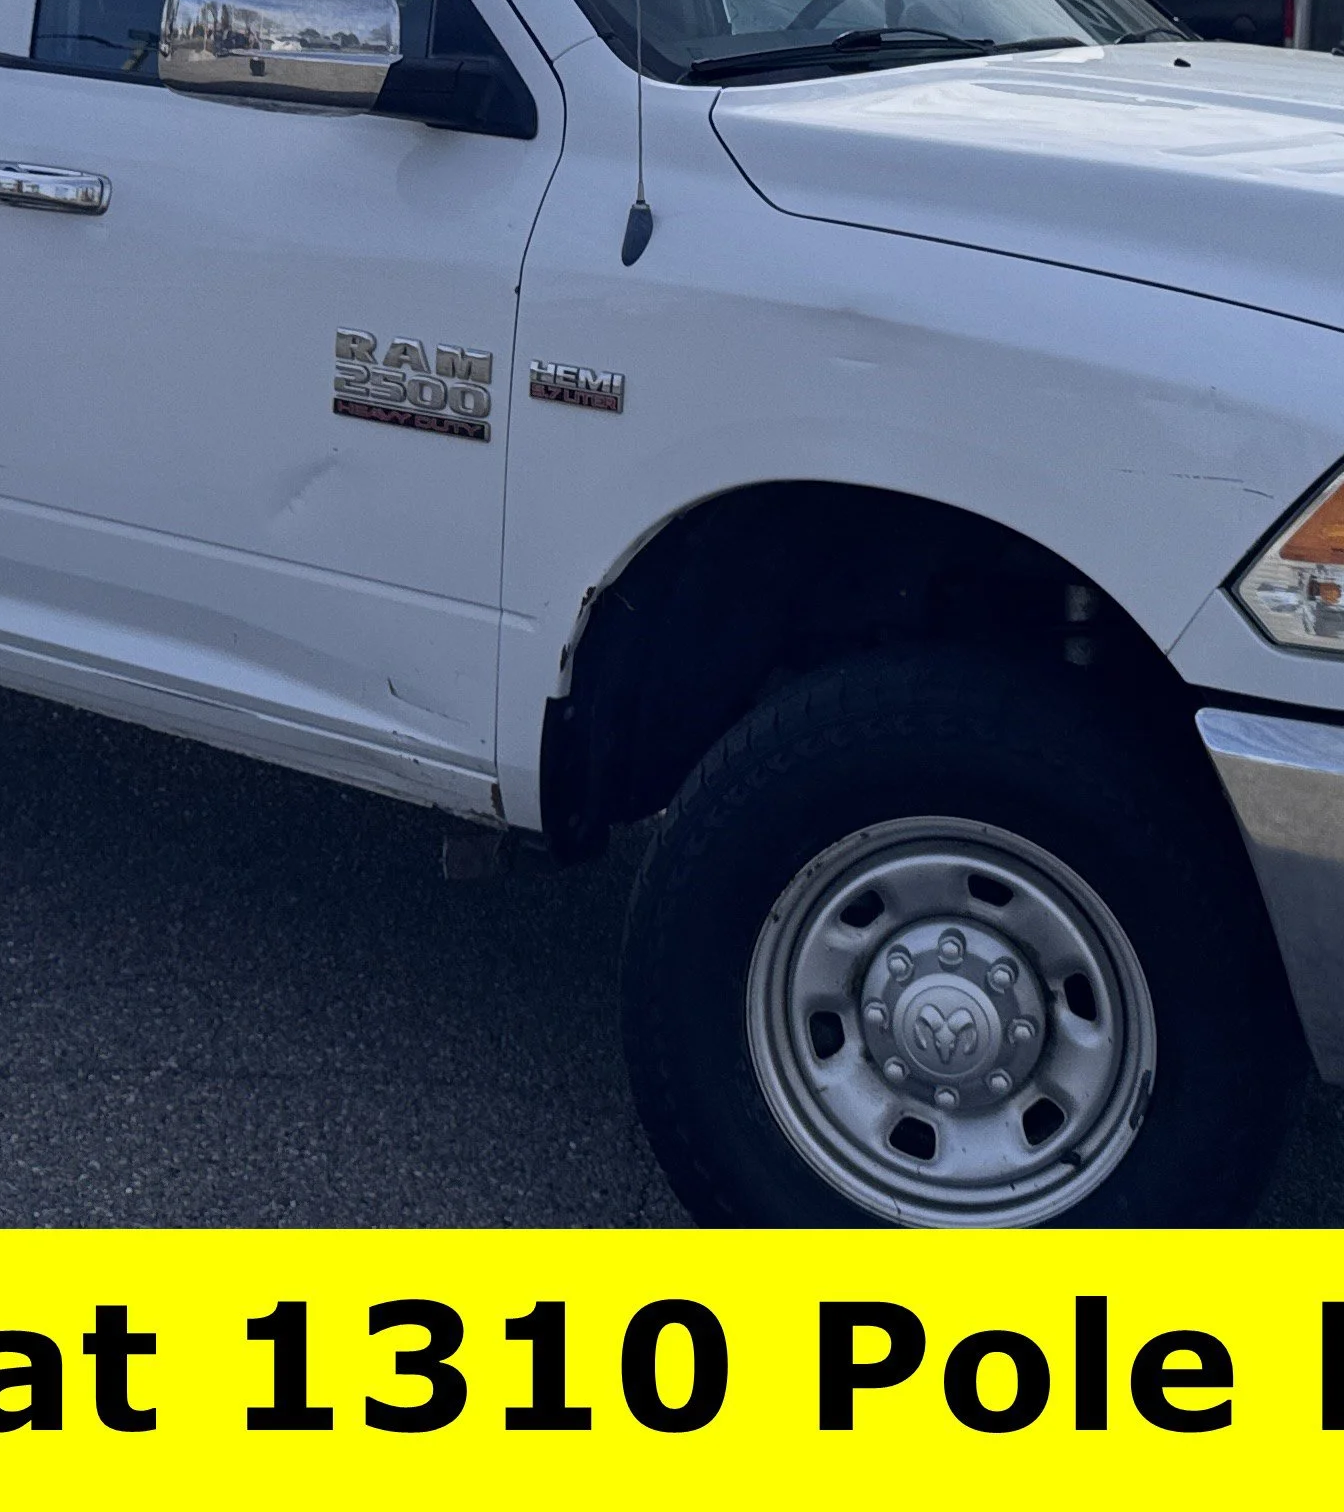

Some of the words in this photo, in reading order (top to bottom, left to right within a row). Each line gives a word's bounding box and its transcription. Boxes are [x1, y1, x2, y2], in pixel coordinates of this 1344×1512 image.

[335, 326, 493, 384] RAM
[334, 360, 492, 419] 2500
[530, 359, 625, 396] HEMI
[531, 383, 562, 400] 5.7
[563, 389, 617, 410] LITER
[336, 399, 412, 425] HEAVY
[414, 414, 482, 437] DUTY
